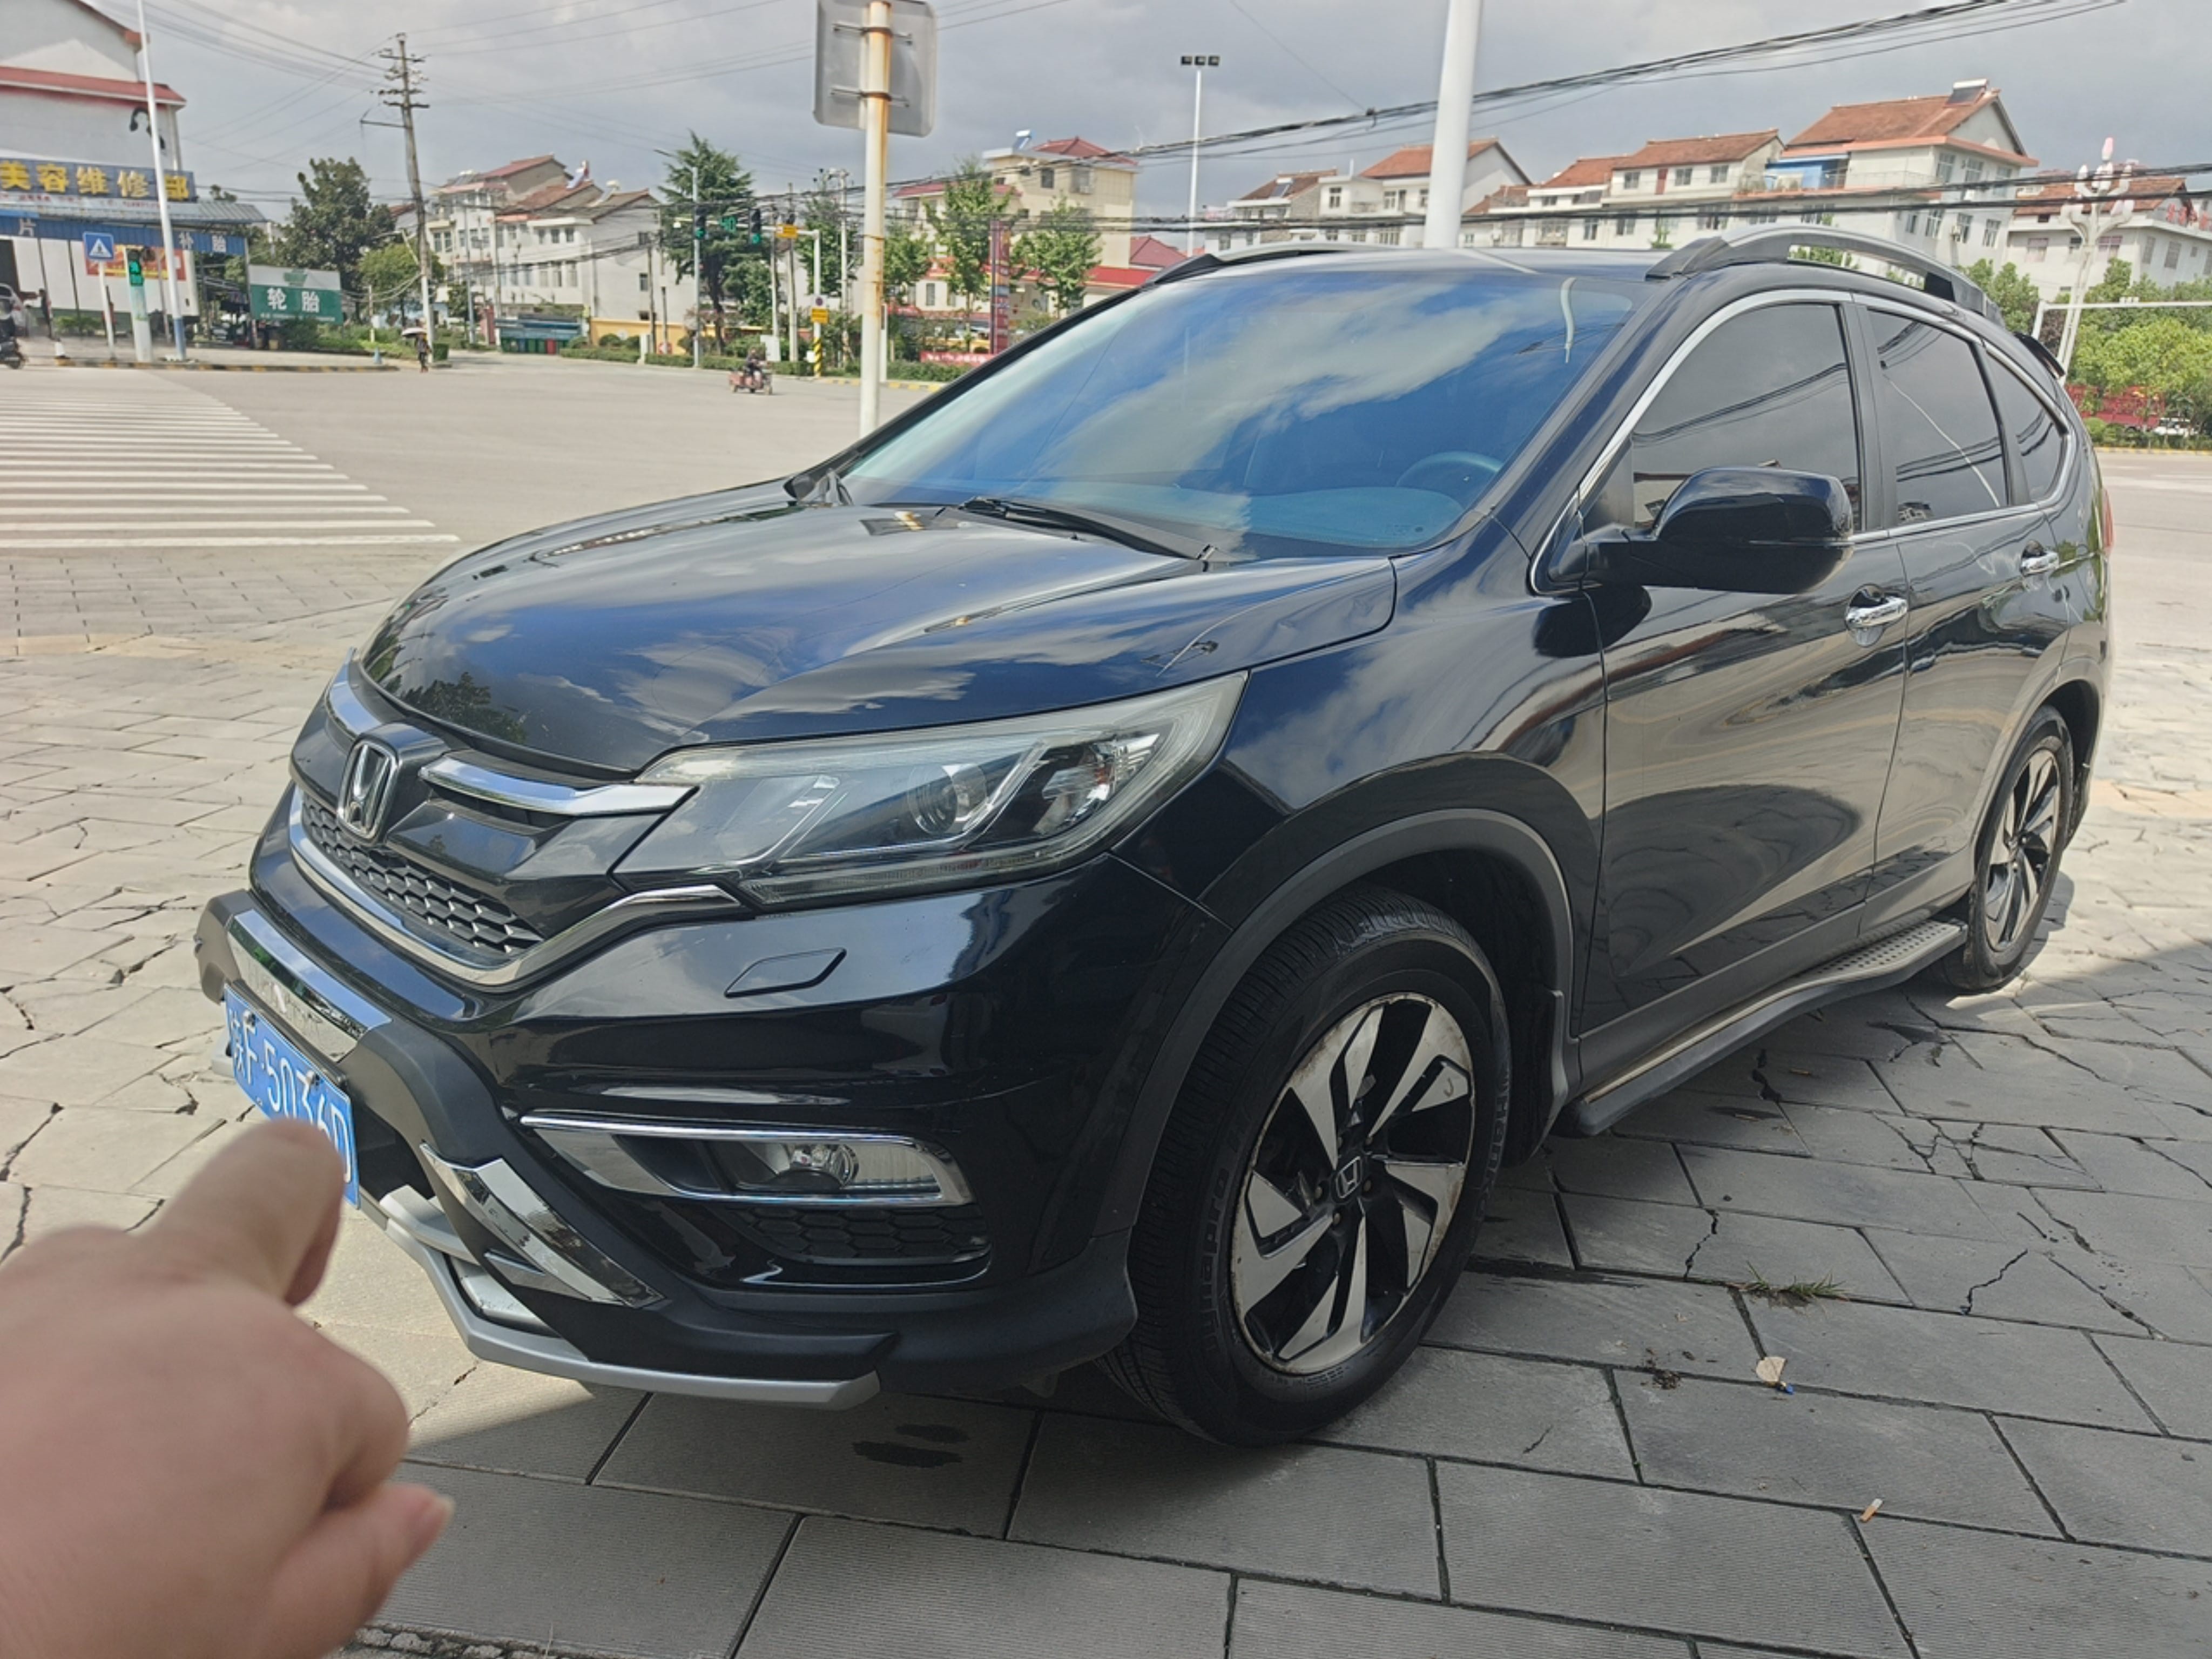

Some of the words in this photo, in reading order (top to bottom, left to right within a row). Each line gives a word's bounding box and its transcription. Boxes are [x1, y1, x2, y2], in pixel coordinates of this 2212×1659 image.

[0, 160, 189, 200] 美容维修部
[267, 288, 320, 313] 轮胎
